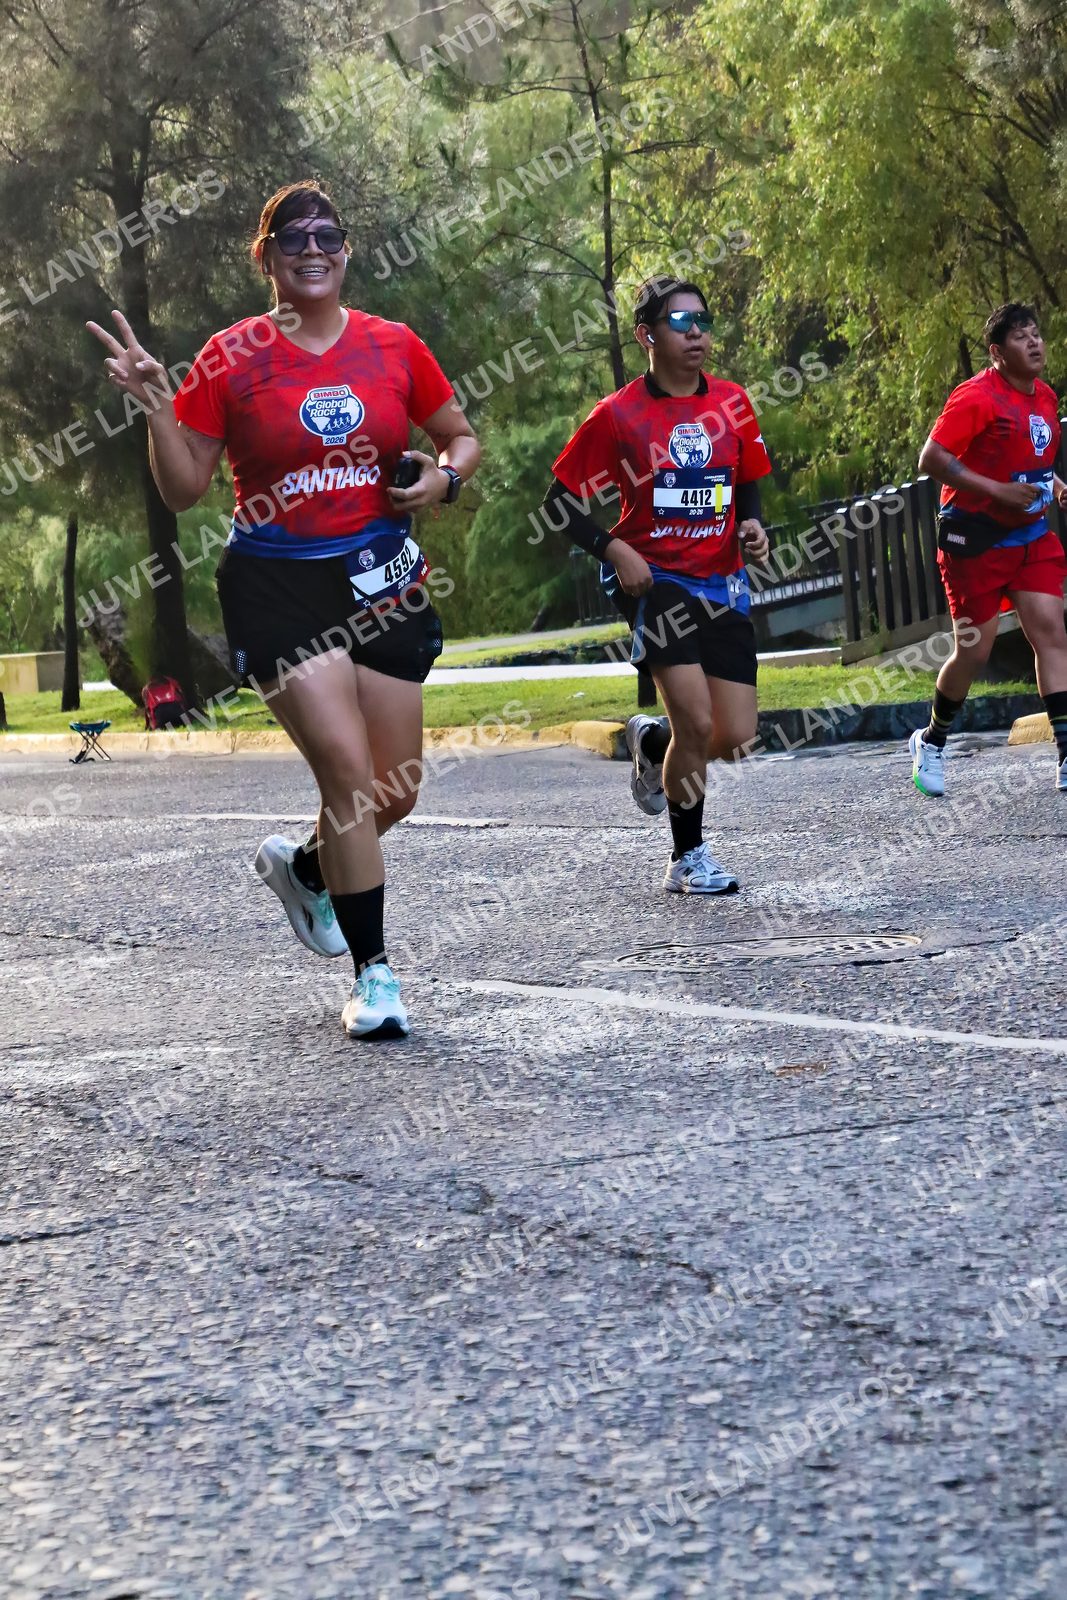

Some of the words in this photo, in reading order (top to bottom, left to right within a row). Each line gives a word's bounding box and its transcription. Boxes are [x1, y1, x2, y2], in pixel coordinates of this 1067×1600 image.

[313, 390, 346, 399] BIMBO
[316, 399, 347, 410] Global
[310, 408, 336, 417] Race
[325, 436, 345, 445] 2026
[676, 445, 694, 453] Race
[282, 465, 381, 495] SANTIAGO
[681, 489, 712, 507] 4412
[384, 545, 415, 584] 4592
